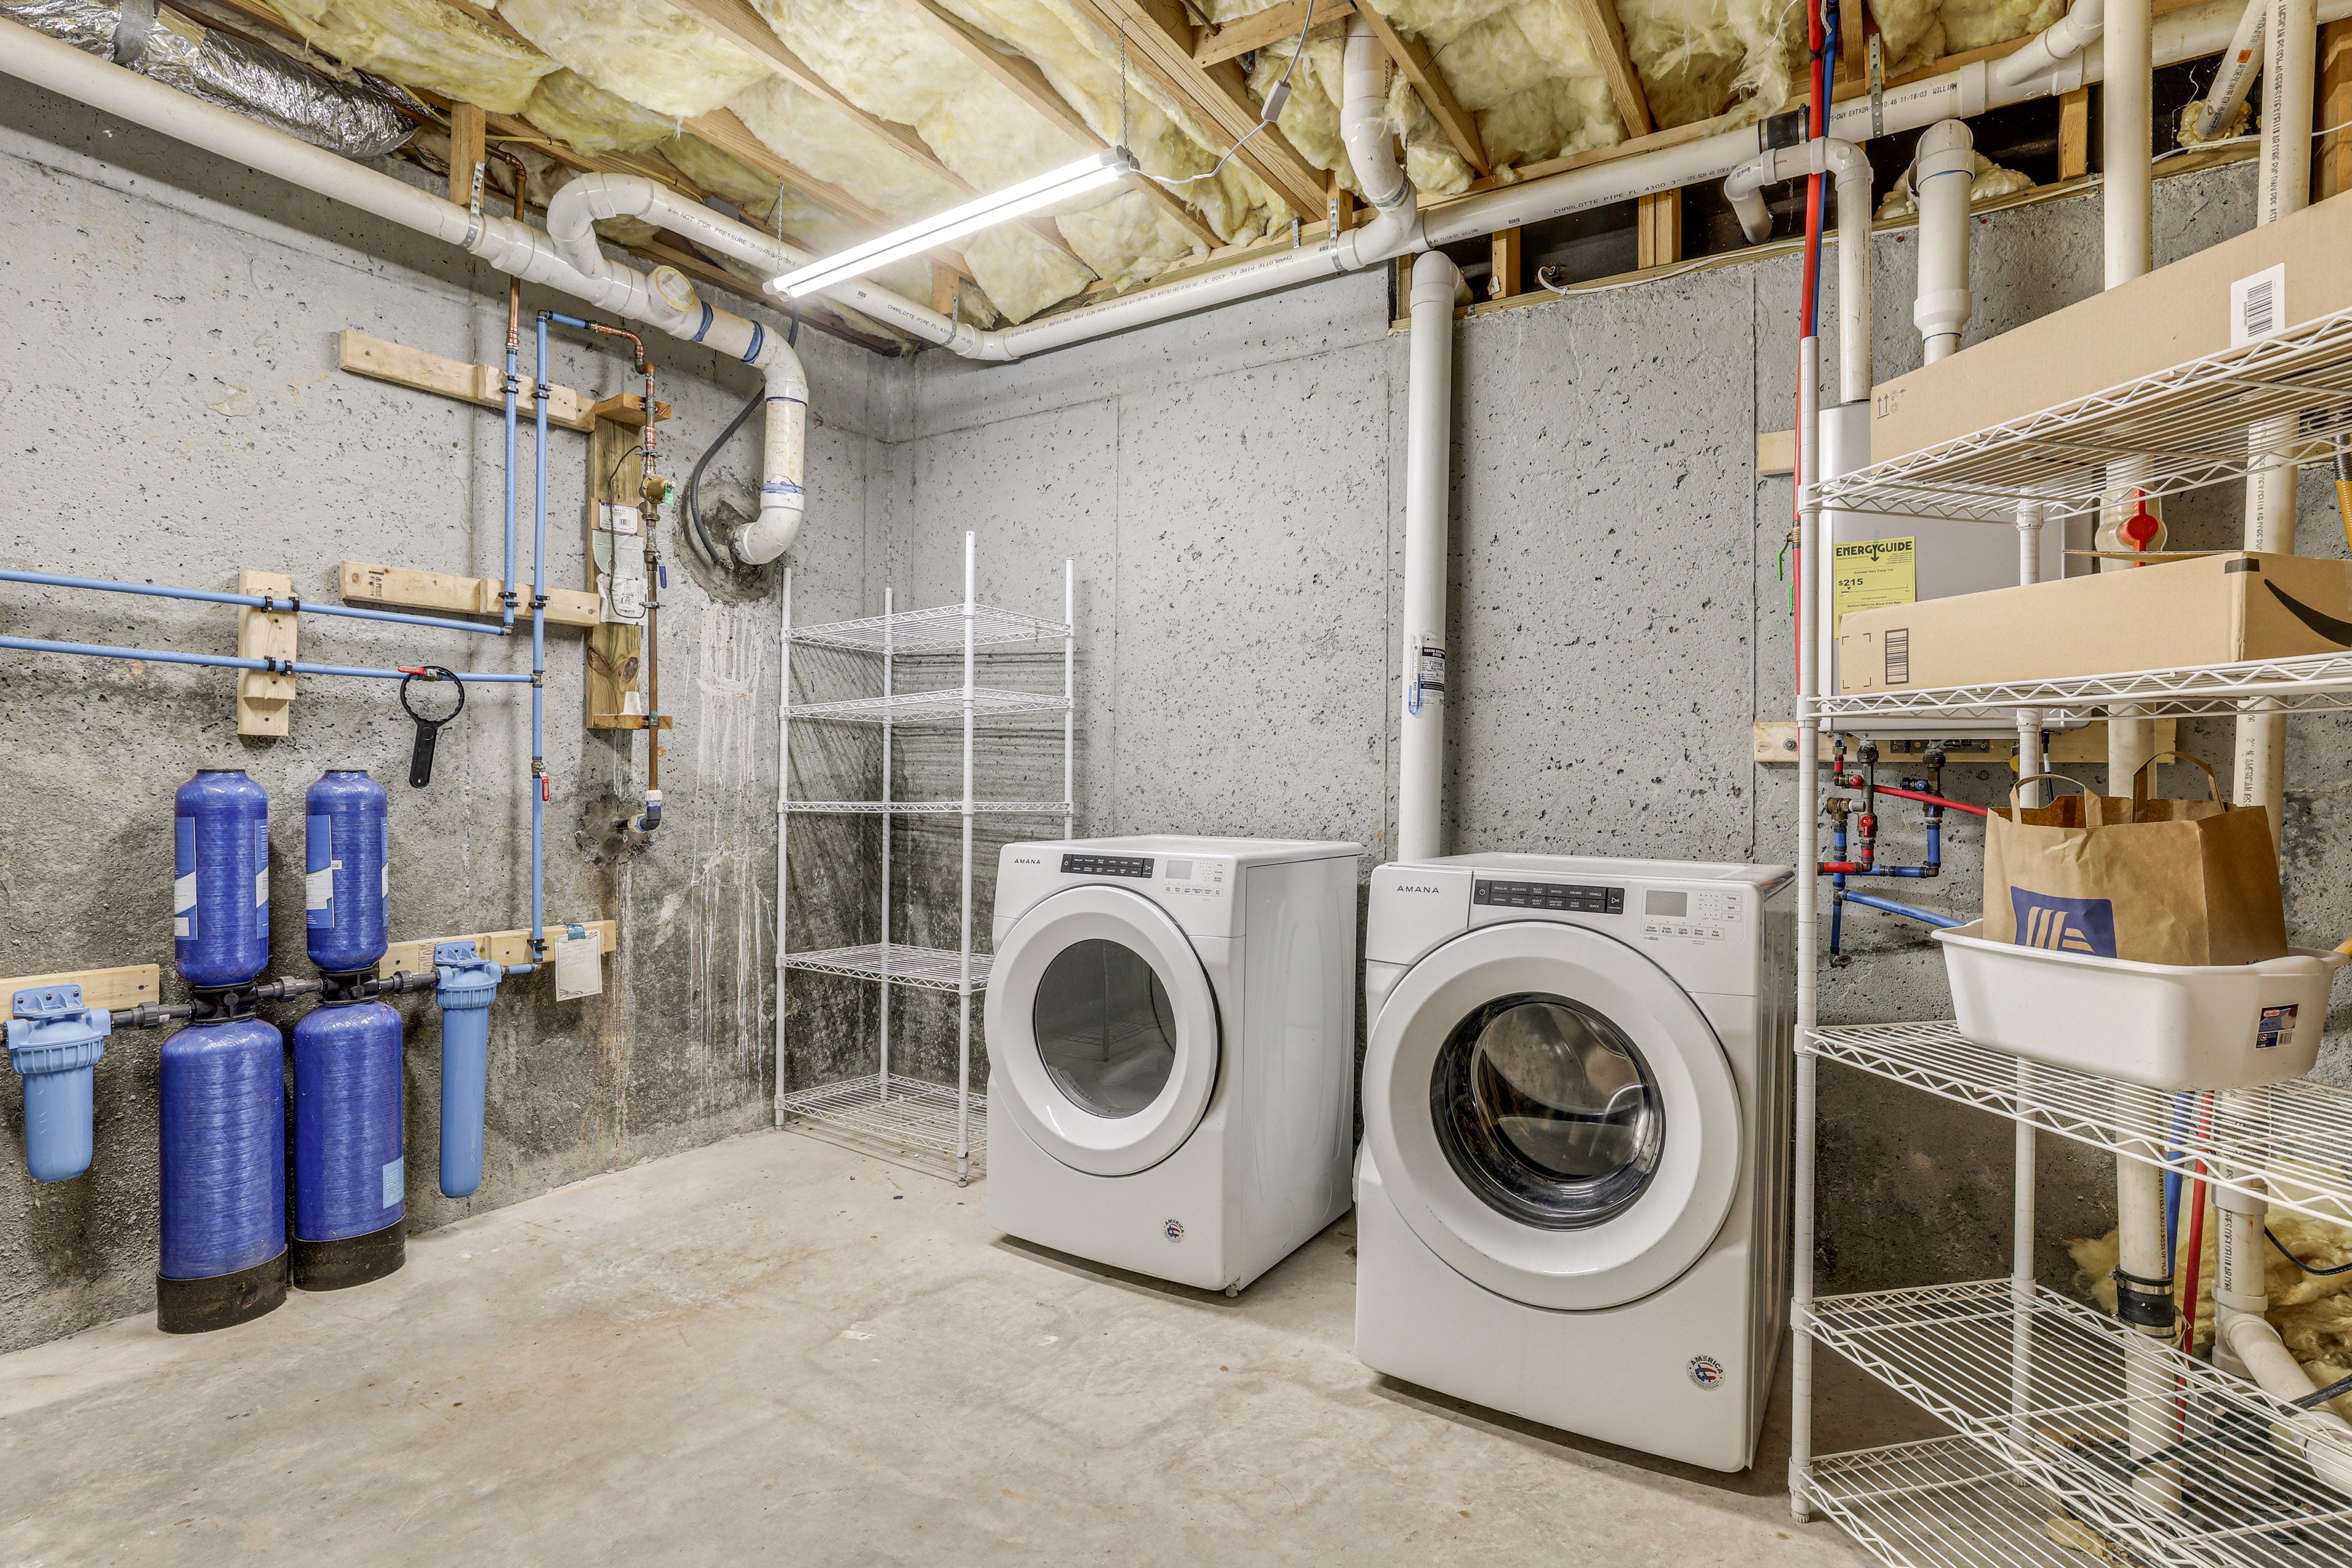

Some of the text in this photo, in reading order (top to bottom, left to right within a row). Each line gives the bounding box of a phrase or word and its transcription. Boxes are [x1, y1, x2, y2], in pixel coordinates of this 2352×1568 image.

[1899, 89, 1928, 103] 11/18/03
[1932, 81, 1958, 94] WILLIAM
[1553, 197, 1599, 214] CHARLOTTE
[1603, 192, 1624, 202] PIPE
[1644, 181, 1666, 192] 4300
[679, 212, 694, 222] NOT
[696, 219, 712, 230] FOR
[714, 227, 748, 246] PRESSURE
[1461, 227, 1479, 236] WILLIAM
[1238, 265, 1255, 274] PIPE
[1257, 254, 1292, 269] CHARLOTTE
[1210, 273, 1226, 281] 4300
[886, 303, 915, 320] CHARLOTTE
[916, 316, 930, 326] PIPE
[1047, 316, 1072, 327] PRESSURE
[1836, 541, 1912, 558] ENERGYGUIDE
[2243, 758, 2253, 791] AMERICAN
[2242, 793, 2252, 803] IPS
[1165, 1219, 1185, 1234] AMERICA
[1691, 1356, 1724, 1374] AMERICA
